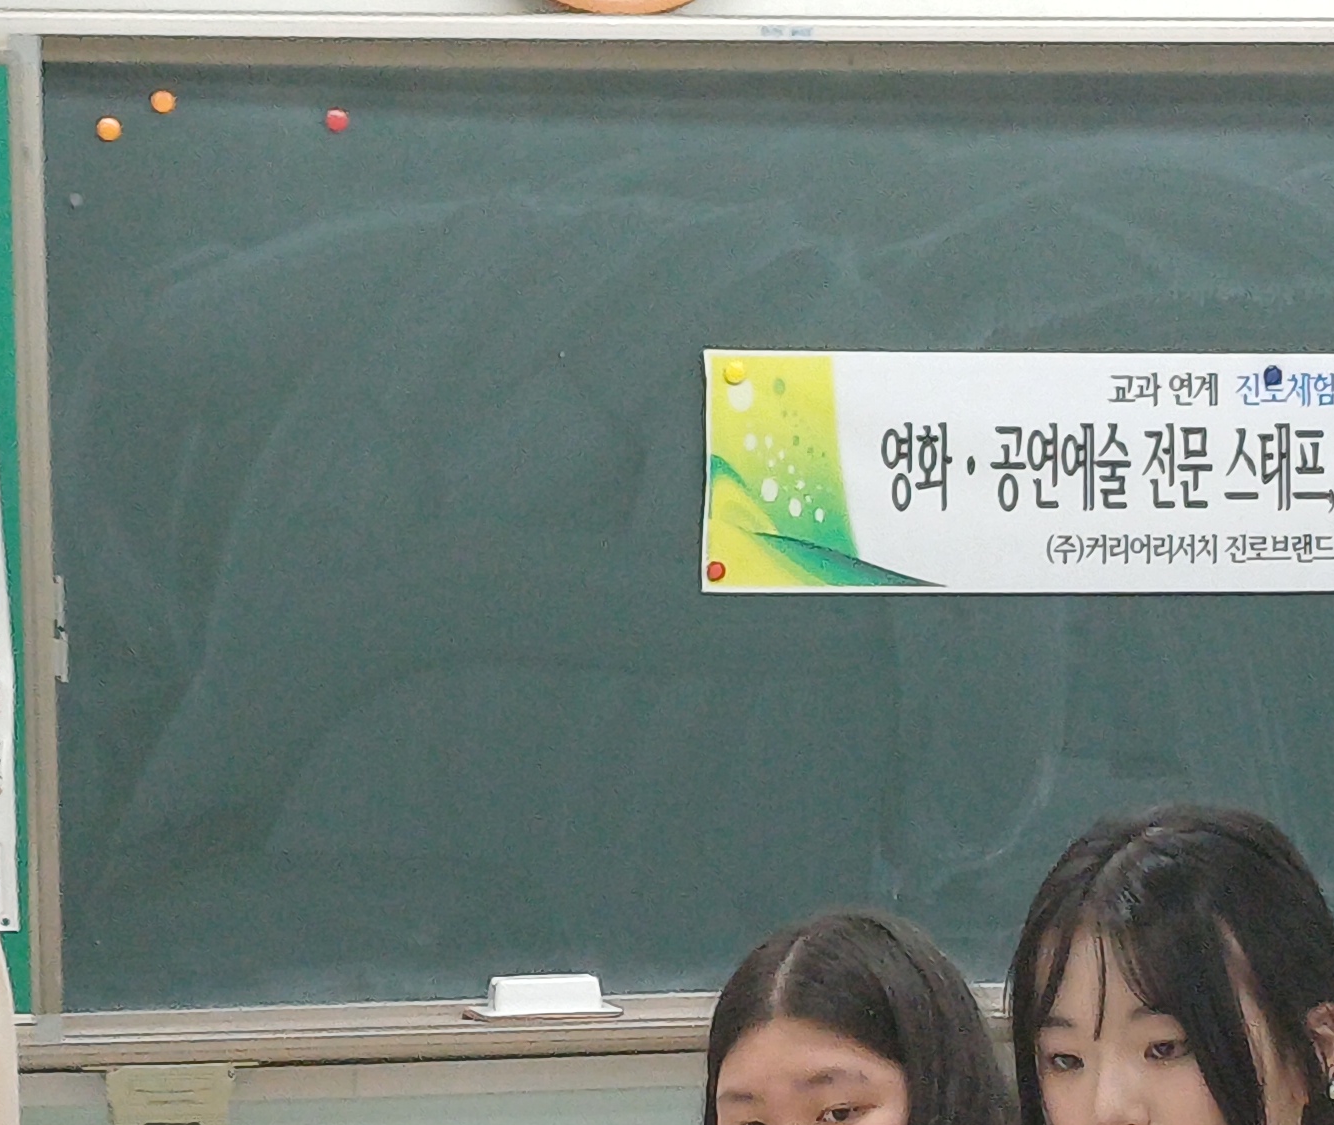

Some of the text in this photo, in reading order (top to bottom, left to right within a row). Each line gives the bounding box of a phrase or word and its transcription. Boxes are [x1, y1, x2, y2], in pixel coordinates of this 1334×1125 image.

[1107, 372, 1162, 407] 교과
[1168, 372, 1219, 406] 연계
[1141, 422, 1213, 510] 전문
[1046, 533, 1219, 566] (주)커리어리서치
